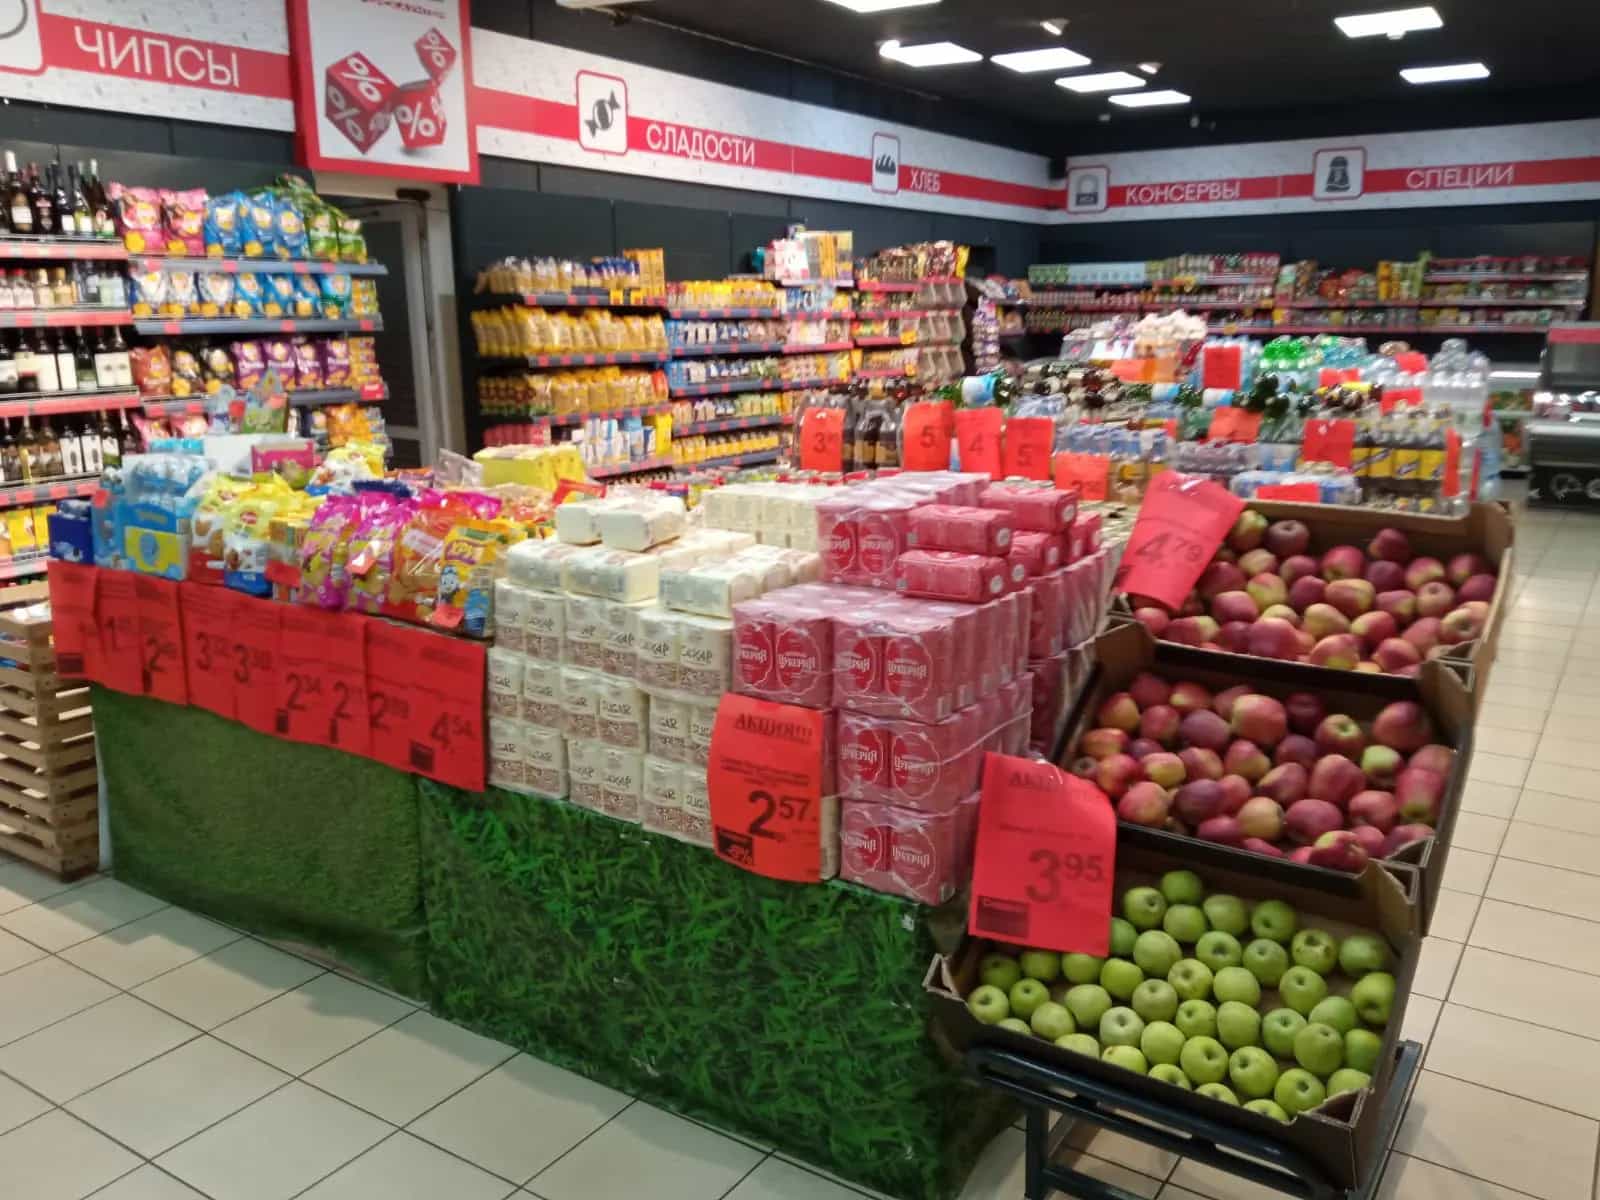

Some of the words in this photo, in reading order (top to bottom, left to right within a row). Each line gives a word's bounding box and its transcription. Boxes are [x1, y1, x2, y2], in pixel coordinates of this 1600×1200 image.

[73, 26, 239, 88] ЧИПСЫ
[645, 123, 756, 165] СЛАДОСТИ
[909, 168, 942, 194] ХЛЕБ
[1405, 165, 1516, 192] СПЕЦИИ
[1125, 181, 1241, 205] КОНСЕРВЫ
